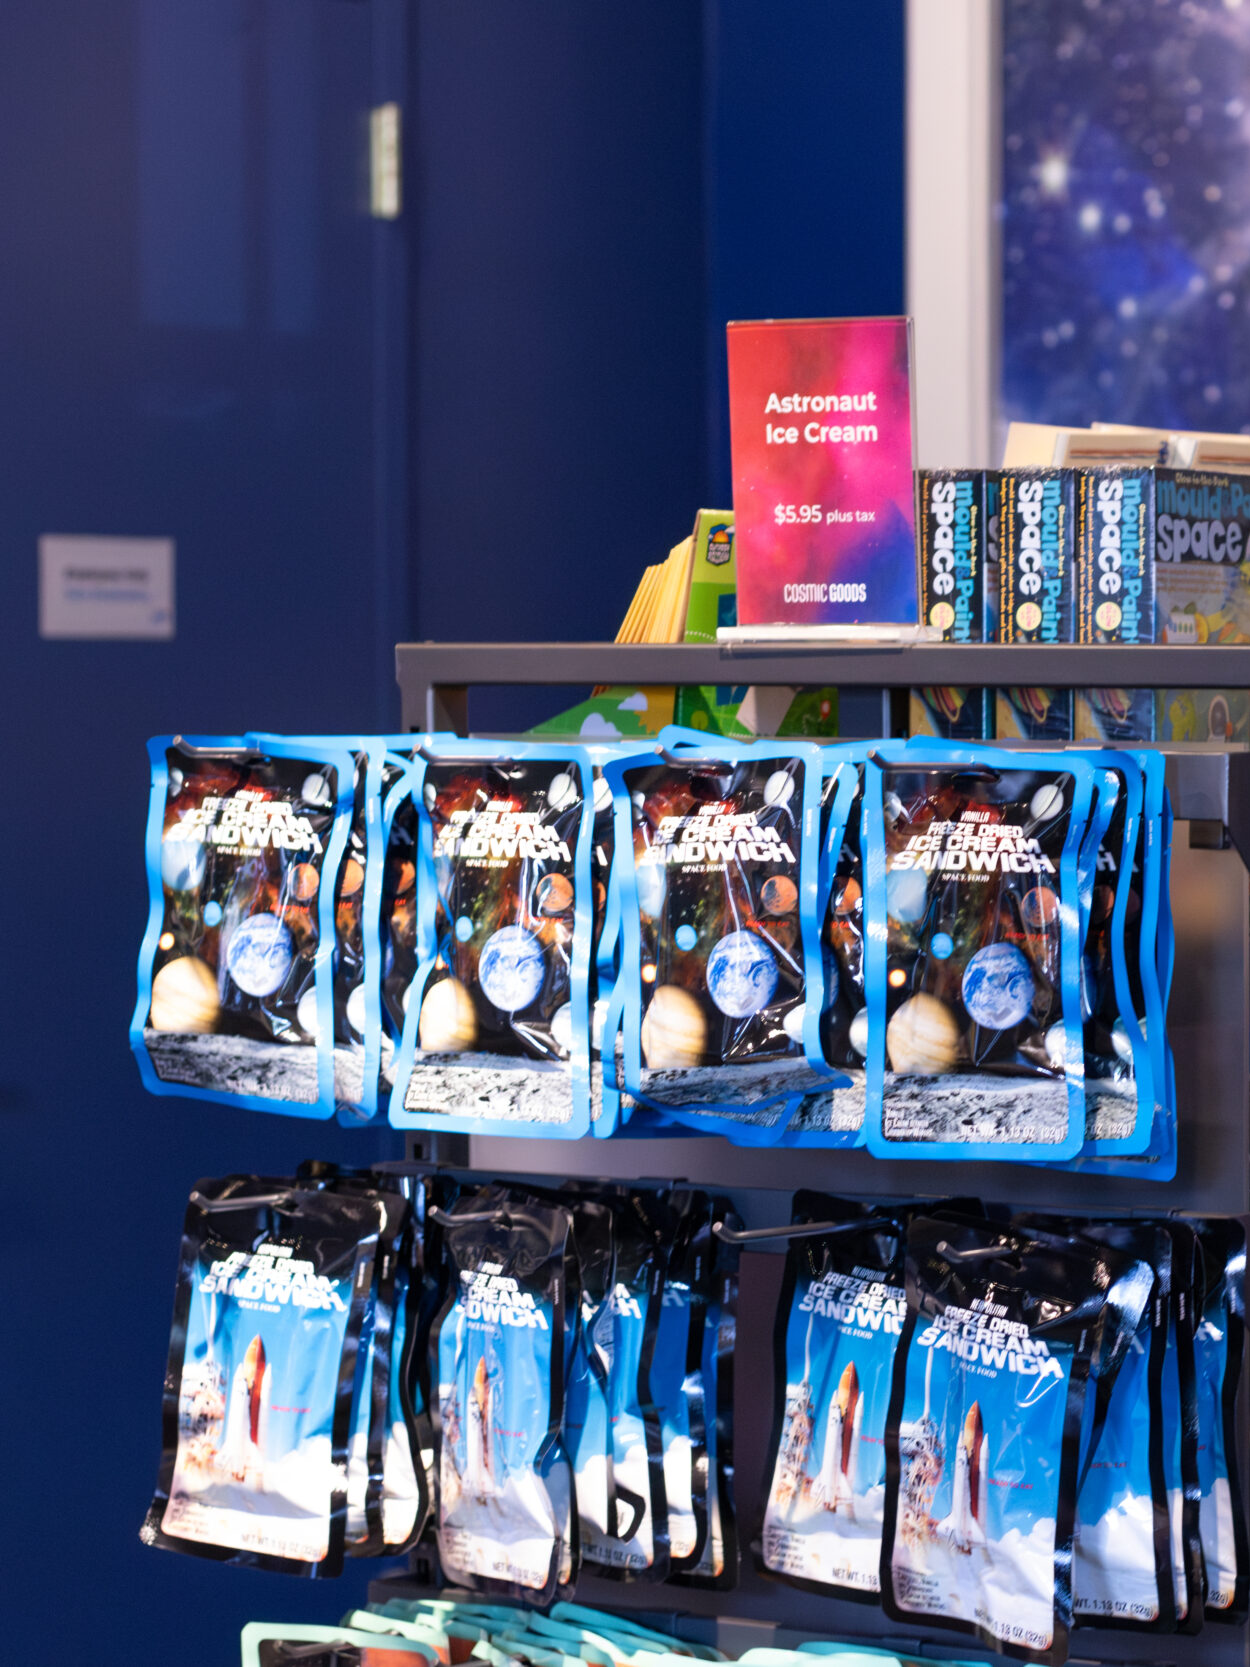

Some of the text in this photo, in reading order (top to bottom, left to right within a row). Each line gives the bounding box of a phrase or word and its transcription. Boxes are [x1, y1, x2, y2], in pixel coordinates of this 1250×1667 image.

[765, 392, 877, 414] Astronaut
[766, 422, 878, 444] Ice Cream
[774, 503, 876, 525] $5.95 plus tax
[784, 583, 867, 603] COSMIC GOODS
[222, 811, 313, 833] CREAM
[960, 810, 990, 823] VANILLA
[468, 824, 560, 842] CREAM
[682, 826, 781, 843] CREAM
[927, 821, 1024, 838] FREEZE DRIED
[906, 834, 1042, 854] ICE CREAM
[891, 851, 1057, 873] SANDWICH
[942, 873, 990, 883] SPACE FOOD
[808, 1281, 837, 1300] ICE
[823, 1271, 906, 1301] FREEZE DRIED
[944, 1305, 1029, 1338] FREEZE DRIED
[932, 1314, 1050, 1357] ICE CREAM
[917, 1327, 1064, 1379] SANDWICH
[832, 1567, 846, 1579] NET
